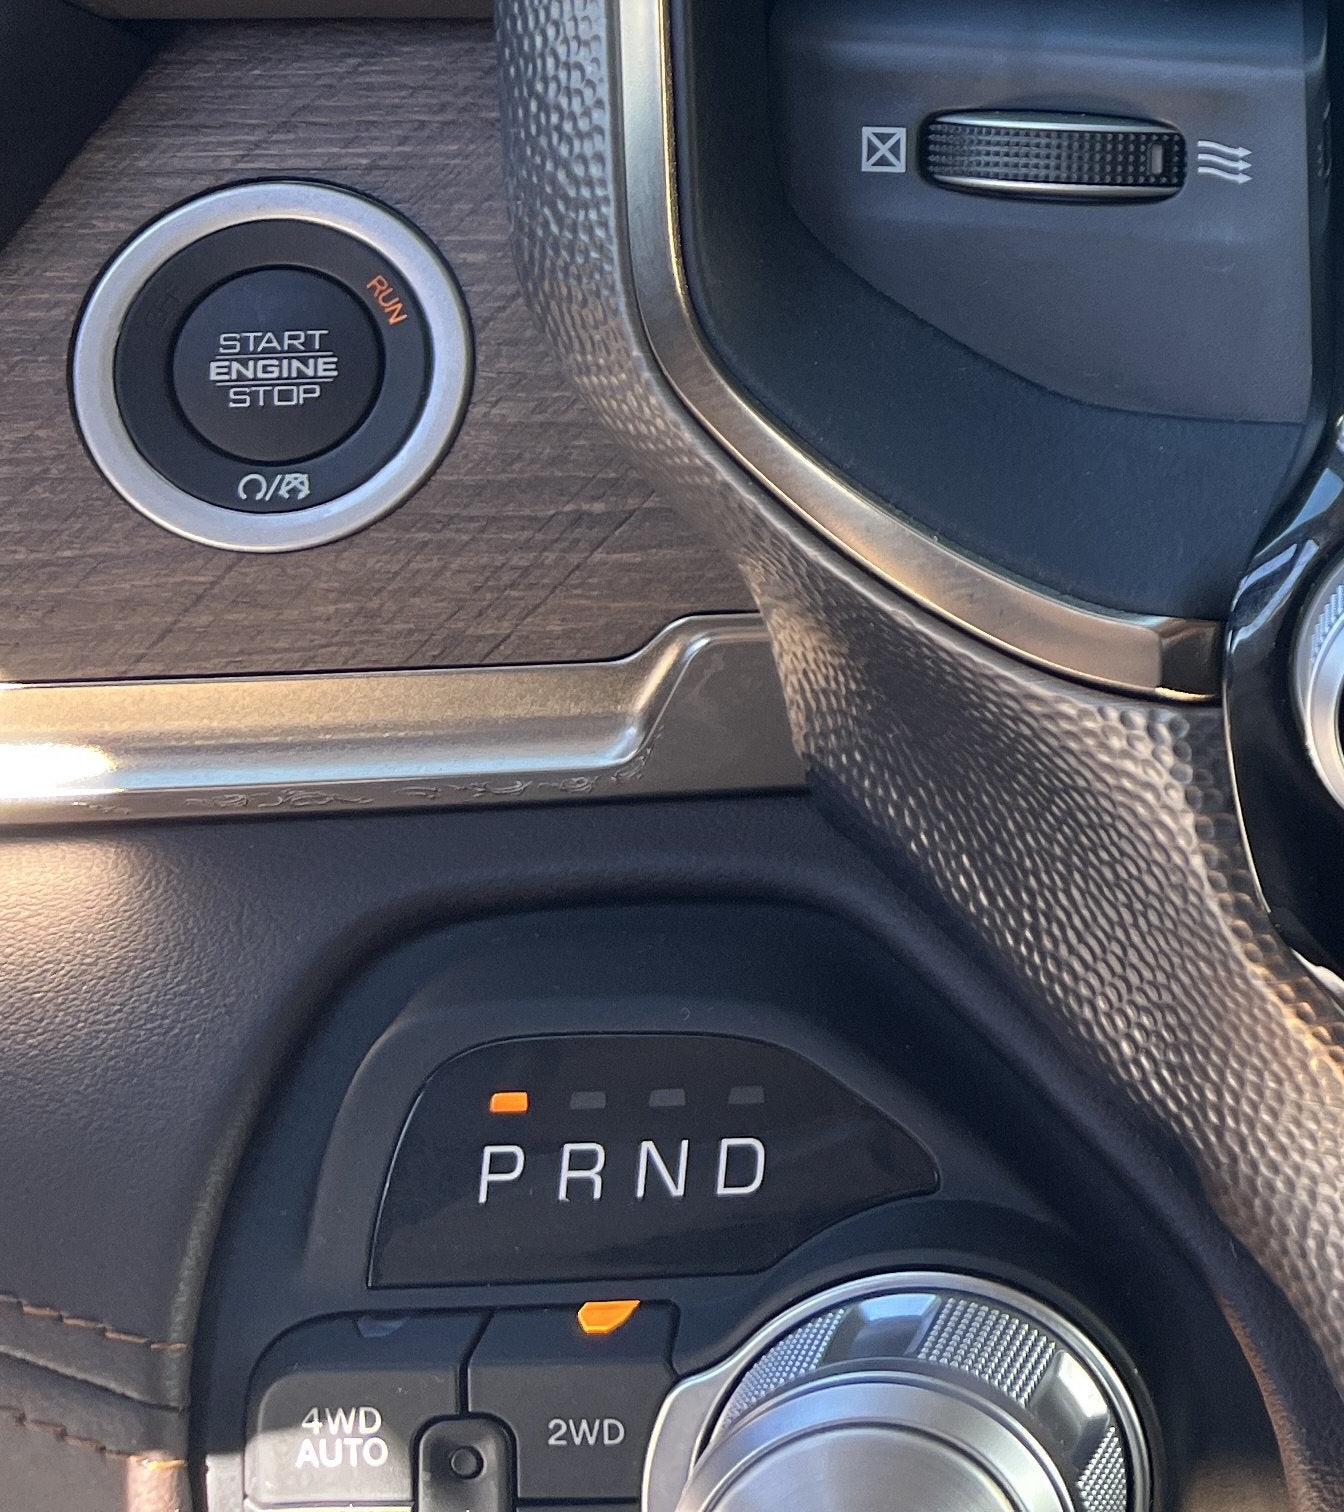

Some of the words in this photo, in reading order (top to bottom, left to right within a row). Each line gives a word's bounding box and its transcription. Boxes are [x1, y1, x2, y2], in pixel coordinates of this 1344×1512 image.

[365, 274, 409, 326] RUN
[218, 329, 330, 355] START
[208, 356, 339, 382] ENGINE
[228, 384, 321, 409] STOP
[477, 1144, 526, 1204] P
[558, 1142, 606, 1202] R
[635, 1139, 690, 1199] N
[715, 1137, 767, 1197] D
[301, 1405, 383, 1435] 4WD
[547, 1418, 626, 1447] 2WD
[296, 1434, 388, 1469] AUTO
